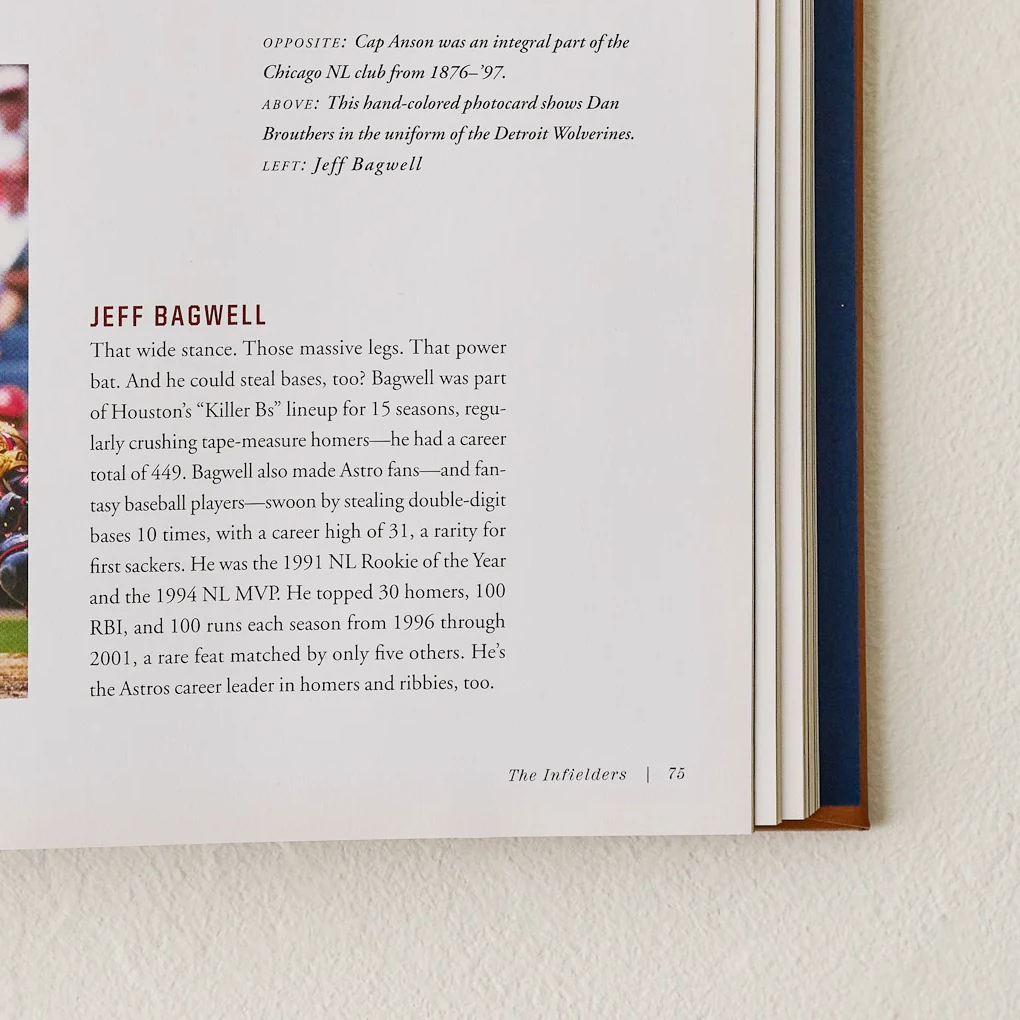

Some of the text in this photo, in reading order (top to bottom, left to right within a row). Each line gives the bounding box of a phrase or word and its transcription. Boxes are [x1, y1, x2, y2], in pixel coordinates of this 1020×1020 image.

[262, 33, 630, 54] OPPOSITE: Cap Anson was an integral part of the
[263, 63, 323, 85] Chicago
[324, 64, 351, 80] NL
[354, 63, 387, 80] club
[385, 63, 426, 84] from
[260, 94, 620, 115] ABOVE: This hand-colored photocard shows Dan
[261, 124, 635, 146] Brouthers in the uniform of the Detroit Wolverines.
[261, 155, 424, 177] LEFT: Jeff Bagwell
[89, 304, 266, 328] JEFF BAGWELL
[89, 337, 508, 361] That wide stance. Those massive legs. That power
[90, 368, 507, 391] bat. And he could steal bases, too? Bagwell was part
[89, 582, 506, 606] and the 1994 NL MVP. He topped 30 homers, 100
[89, 611, 506, 638] RBI, and 100 runs each season from 1996 through
[508, 766, 686, 782] The Infielders 75
